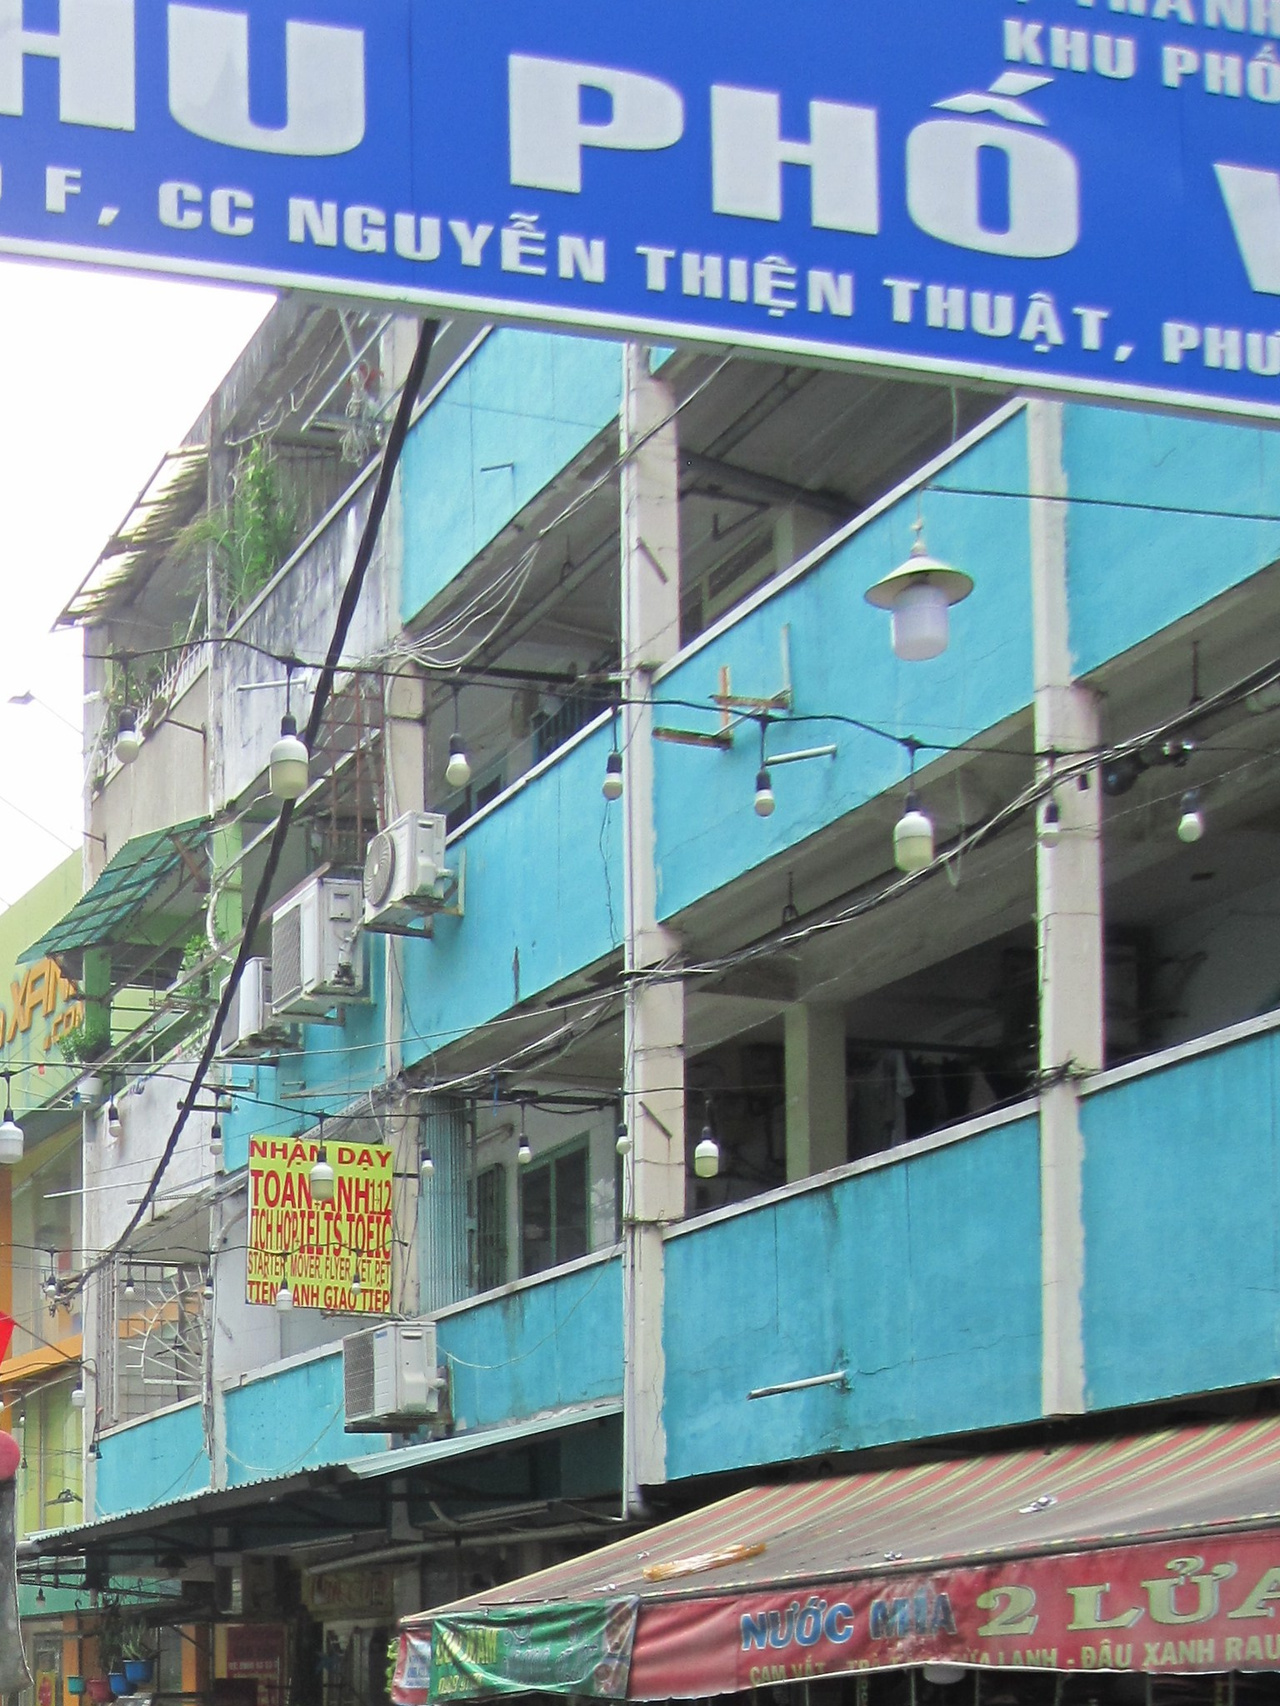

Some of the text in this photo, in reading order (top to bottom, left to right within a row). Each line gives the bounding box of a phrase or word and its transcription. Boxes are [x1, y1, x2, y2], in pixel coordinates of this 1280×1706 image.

[1004, 20, 1135, 80] KHU
[509, 54, 1079, 259] PHỐ
[158, 181, 255, 238] CC
[288, 197, 606, 285] NGUYỄN
[636, 245, 854, 319] THIỆN
[881, 277, 1135, 364] THUẬT,
[338, 1147, 392, 1171] DẠY
[293, 1284, 319, 1307] ANH
[359, 1281, 390, 1313] TIẾP
[375, 1262, 391, 1285] PET
[740, 1596, 854, 1650] NƯỚC
[976, 1585, 1038, 1636] 2
[750, 1667, 785, 1687] CAM
[1144, 1638, 1216, 1667] XANH
[1225, 1633, 1280, 1662] RAU
